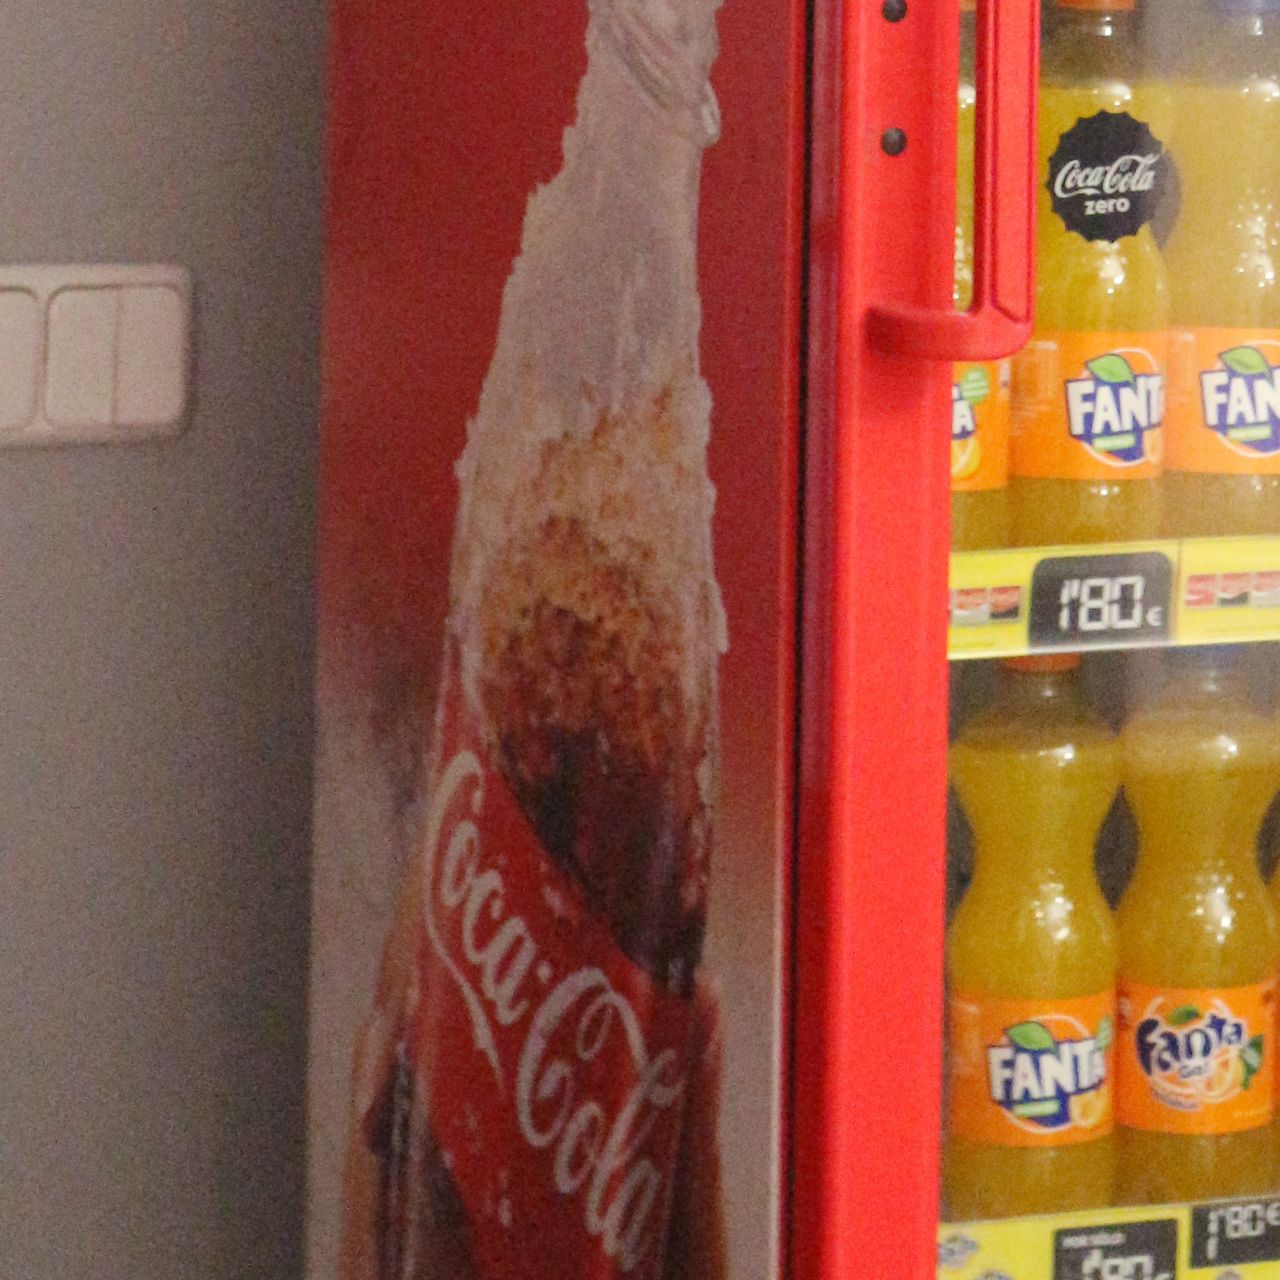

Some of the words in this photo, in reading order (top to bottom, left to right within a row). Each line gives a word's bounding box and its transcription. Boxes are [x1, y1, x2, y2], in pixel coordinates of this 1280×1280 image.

[1054, 153, 1160, 198] Coca-Cola
[1084, 197, 1131, 215] zero
[1064, 373, 1166, 437] FANT
[424, 750, 685, 1272] Coca-Cola
[1135, 1013, 1244, 1077] Fanta
